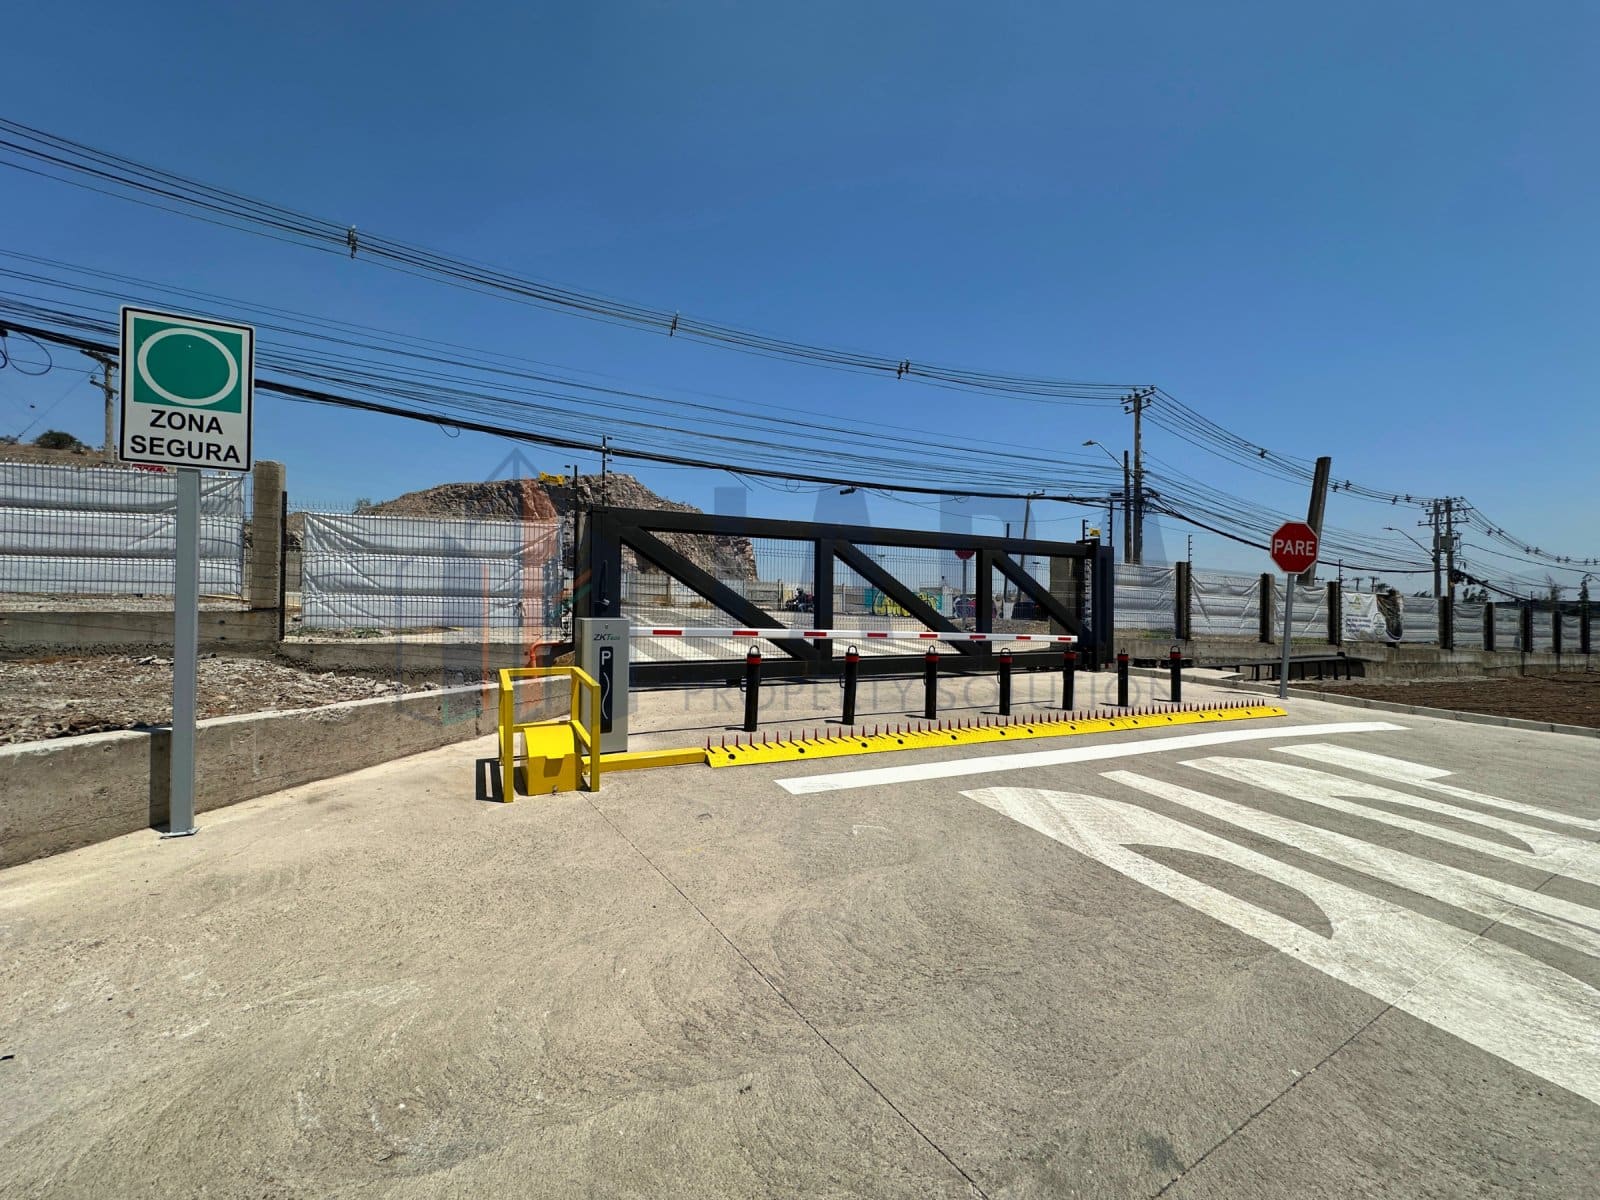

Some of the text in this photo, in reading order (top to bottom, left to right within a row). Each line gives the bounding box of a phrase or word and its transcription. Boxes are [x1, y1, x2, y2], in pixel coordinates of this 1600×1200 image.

[150, 409, 224, 435] ZONA
[130, 435, 241, 463] SEGURA
[1273, 539, 1315, 556] PARE
[601, 650, 611, 665] P
